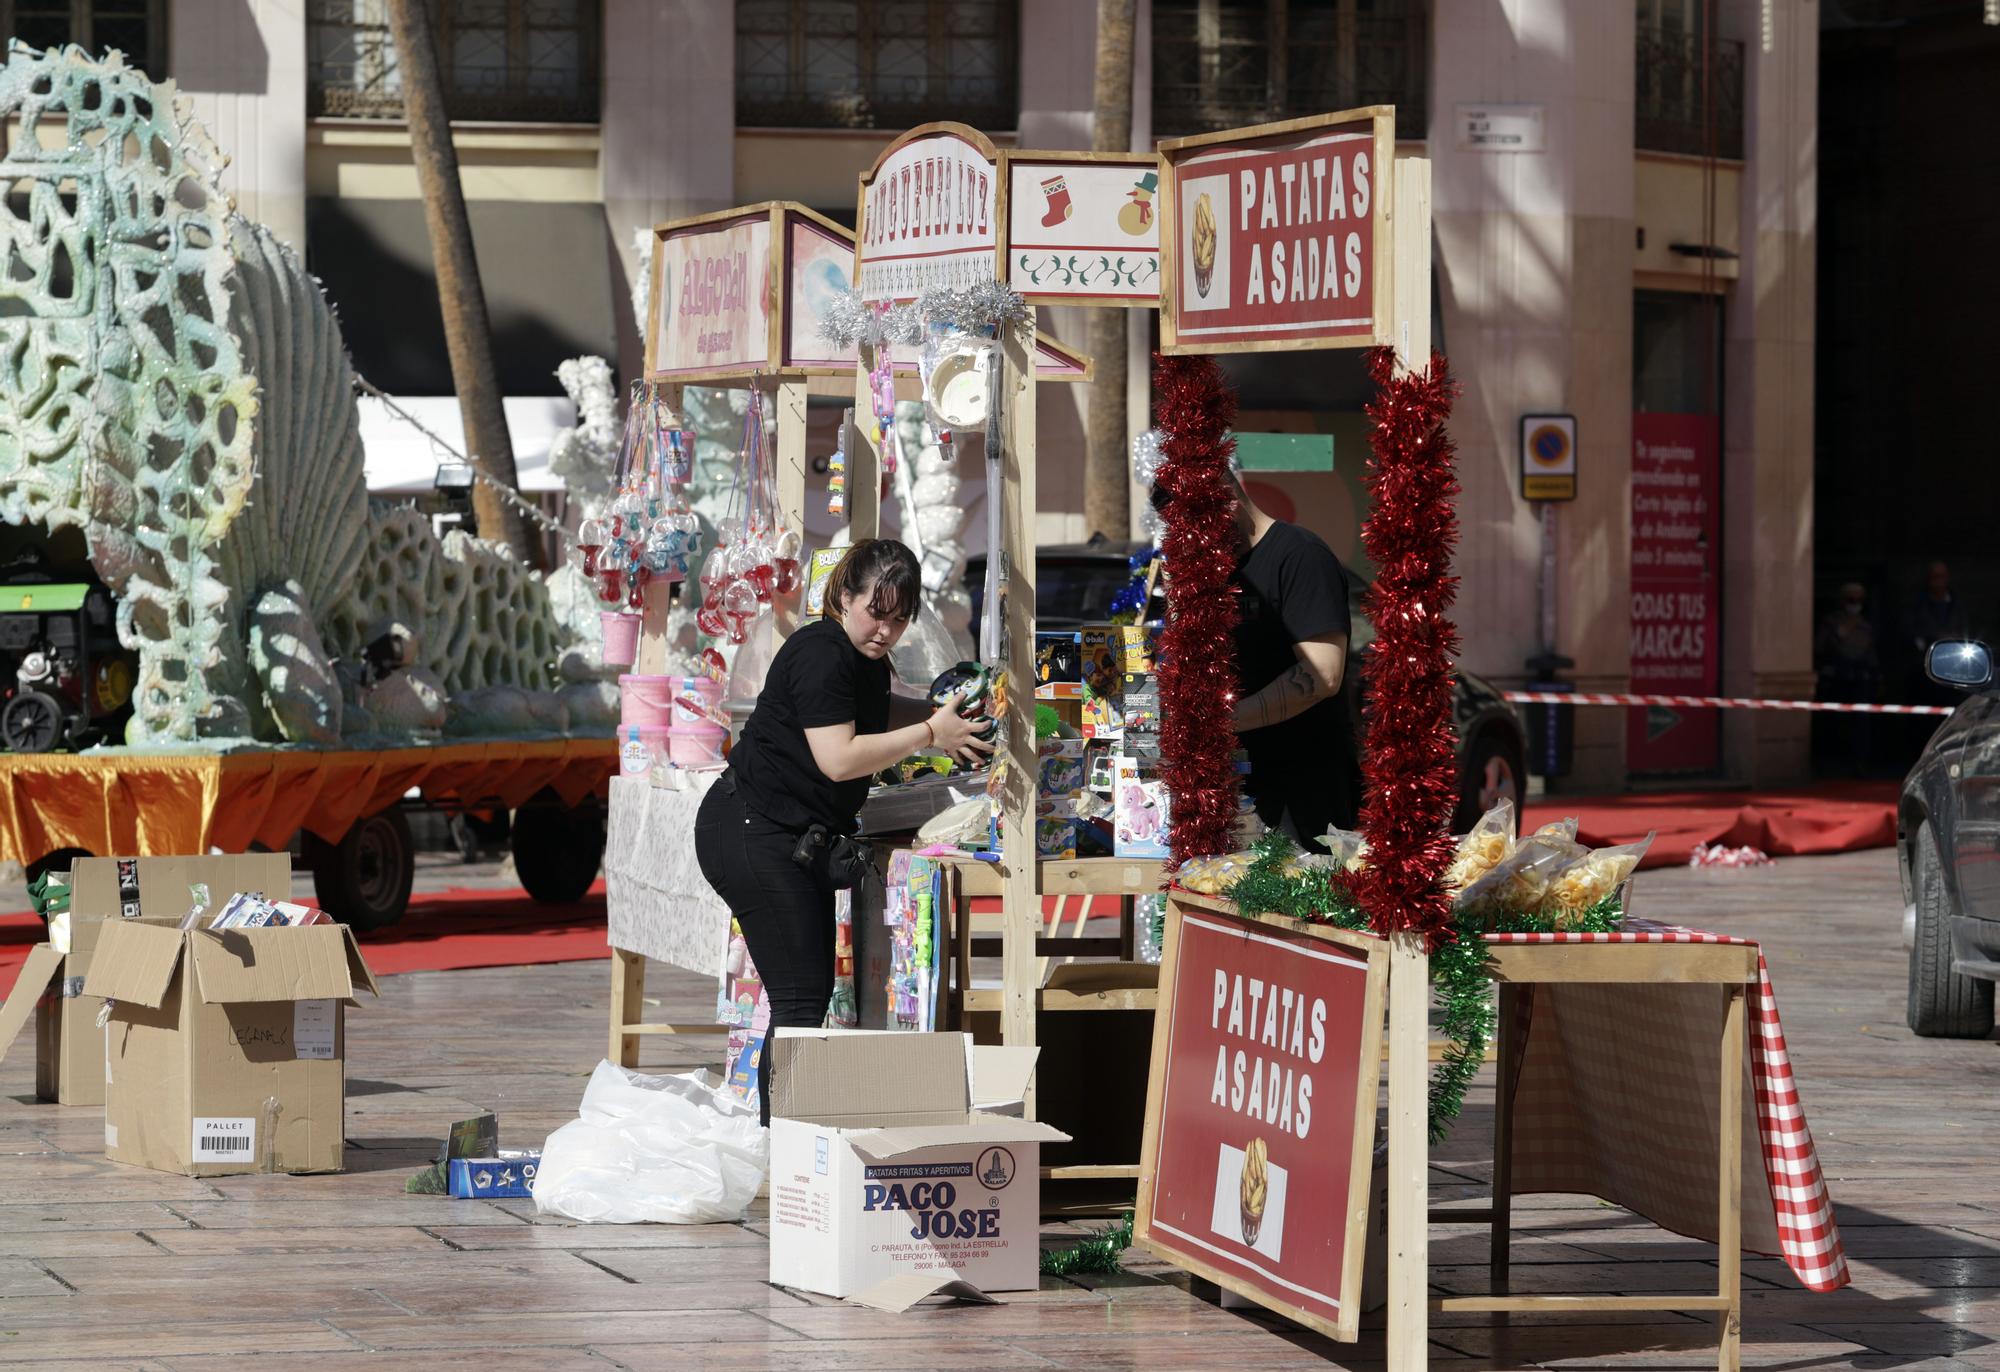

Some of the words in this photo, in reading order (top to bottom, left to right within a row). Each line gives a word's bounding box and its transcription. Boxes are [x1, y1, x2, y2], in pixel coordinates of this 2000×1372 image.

[957, 160, 988, 235] LUZ
[1241, 152, 1369, 230] PATATAS
[1247, 232, 1362, 305] ASADAS
[1631, 593, 1674, 620] ODAS
[1678, 593, 1705, 620] TUS
[1212, 968, 1327, 1064] PATATAS
[1211, 1044, 1312, 1140] ASADAS
[868, 1169, 898, 1177] PATATAS
[899, 1167, 923, 1176] FRITAS
[924, 1167, 930, 1175] Y
[930, 1165, 970, 1175] APERITIVOS
[864, 1181, 956, 1212] PACO
[911, 1209, 1000, 1240] JOSE
[891, 1253, 927, 1261] TELEFONO
[972, 1240, 1009, 1249] ESTRELLA)
[938, 1261, 966, 1269] MALAGA
